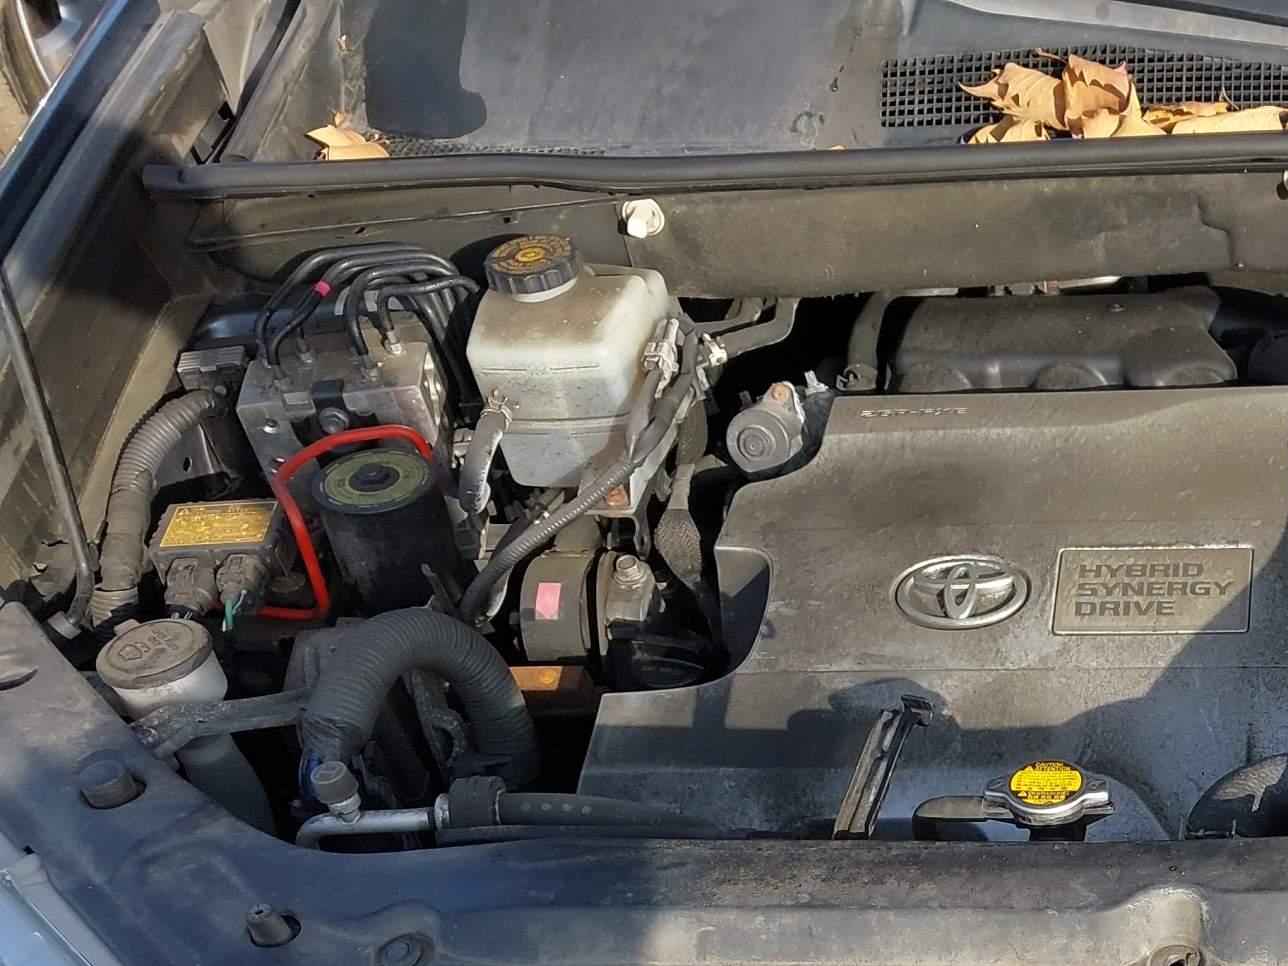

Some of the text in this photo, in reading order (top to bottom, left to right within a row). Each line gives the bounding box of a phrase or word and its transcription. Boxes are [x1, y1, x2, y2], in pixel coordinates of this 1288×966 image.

[1078, 562, 1204, 578] HYBRID
[1075, 581, 1235, 597] SYNERGY
[1074, 600, 1176, 617] DRIVE
